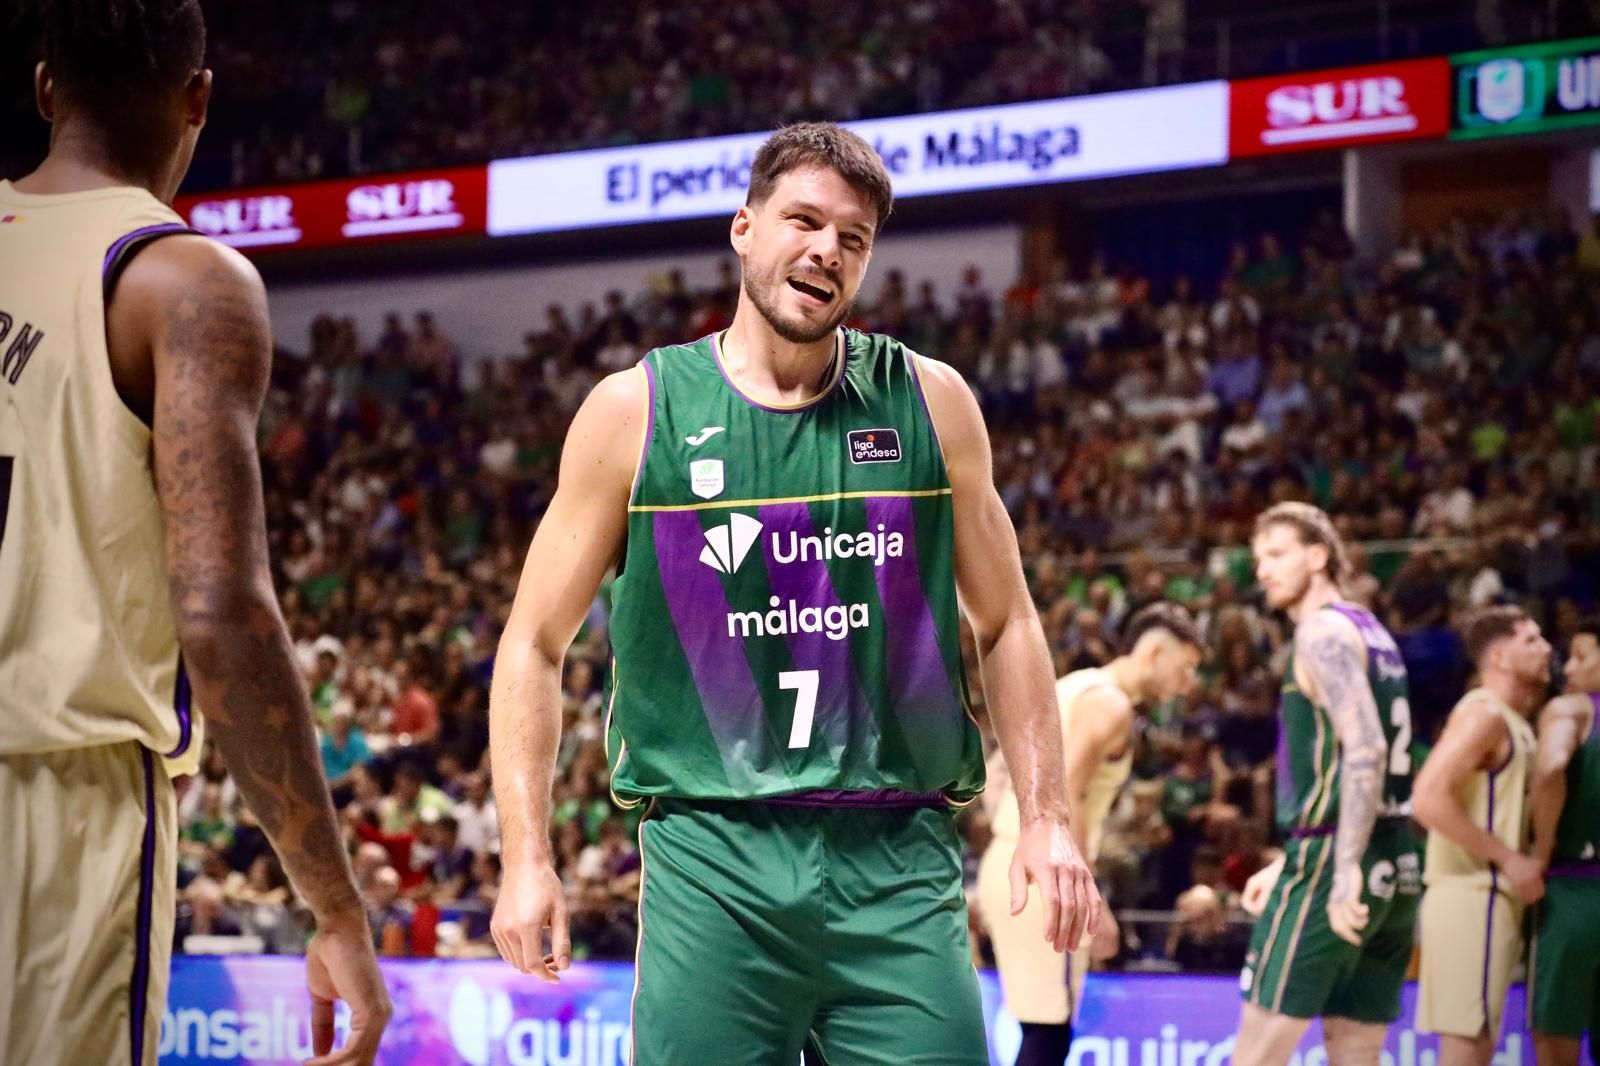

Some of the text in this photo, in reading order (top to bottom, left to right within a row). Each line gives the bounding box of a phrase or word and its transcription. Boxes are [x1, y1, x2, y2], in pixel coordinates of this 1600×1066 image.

[1266, 77, 1406, 126] SUR
[607, 162, 639, 202] El
[923, 122, 1080, 170] Málaga
[190, 195, 296, 234] SUR
[347, 180, 456, 221] SUR
[854, 440, 874, 451] liga
[855, 448, 898, 459] endesa
[772, 523, 904, 566] Unicaja
[778, 669, 819, 749] 7
